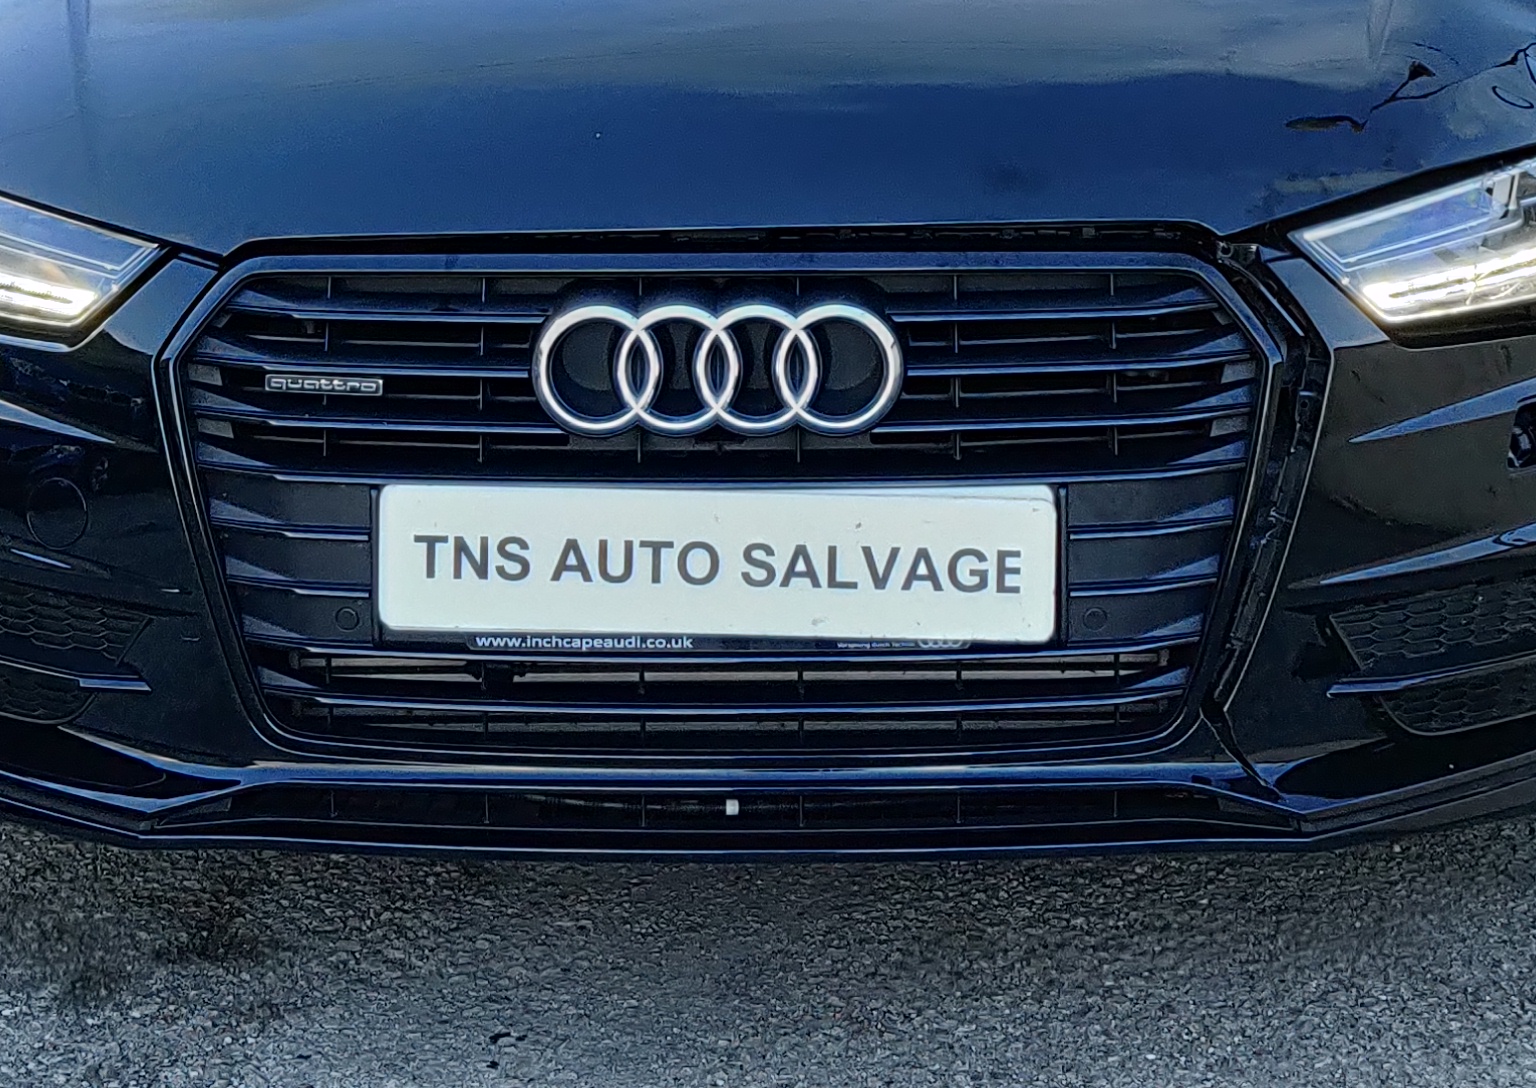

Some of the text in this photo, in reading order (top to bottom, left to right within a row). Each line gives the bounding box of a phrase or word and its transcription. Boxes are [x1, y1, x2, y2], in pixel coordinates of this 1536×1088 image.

[270, 377, 377, 392] quattro
[414, 534, 1022, 595] TNS AUTO SALVAGE
[476, 635, 693, 652] www.inchcapeaudi.co.uk
